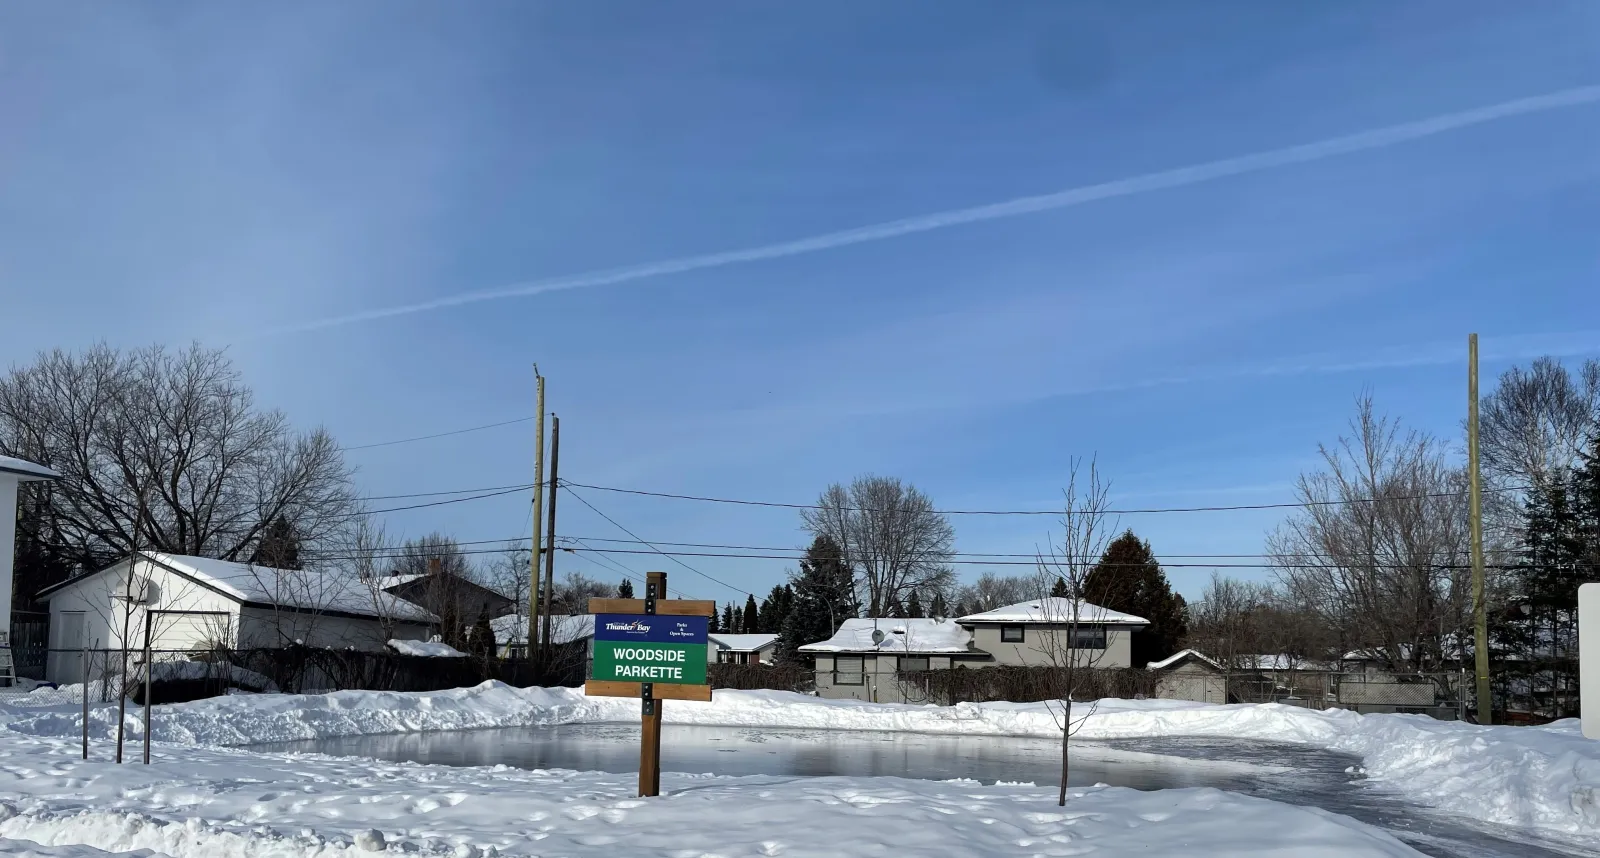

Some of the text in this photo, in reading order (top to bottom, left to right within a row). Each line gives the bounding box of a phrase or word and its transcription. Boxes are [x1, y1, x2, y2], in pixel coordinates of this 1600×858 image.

[637, 624, 651, 632] Bay
[614, 648, 686, 662] WOODSIDE
[615, 665, 682, 678] PARKETTE
